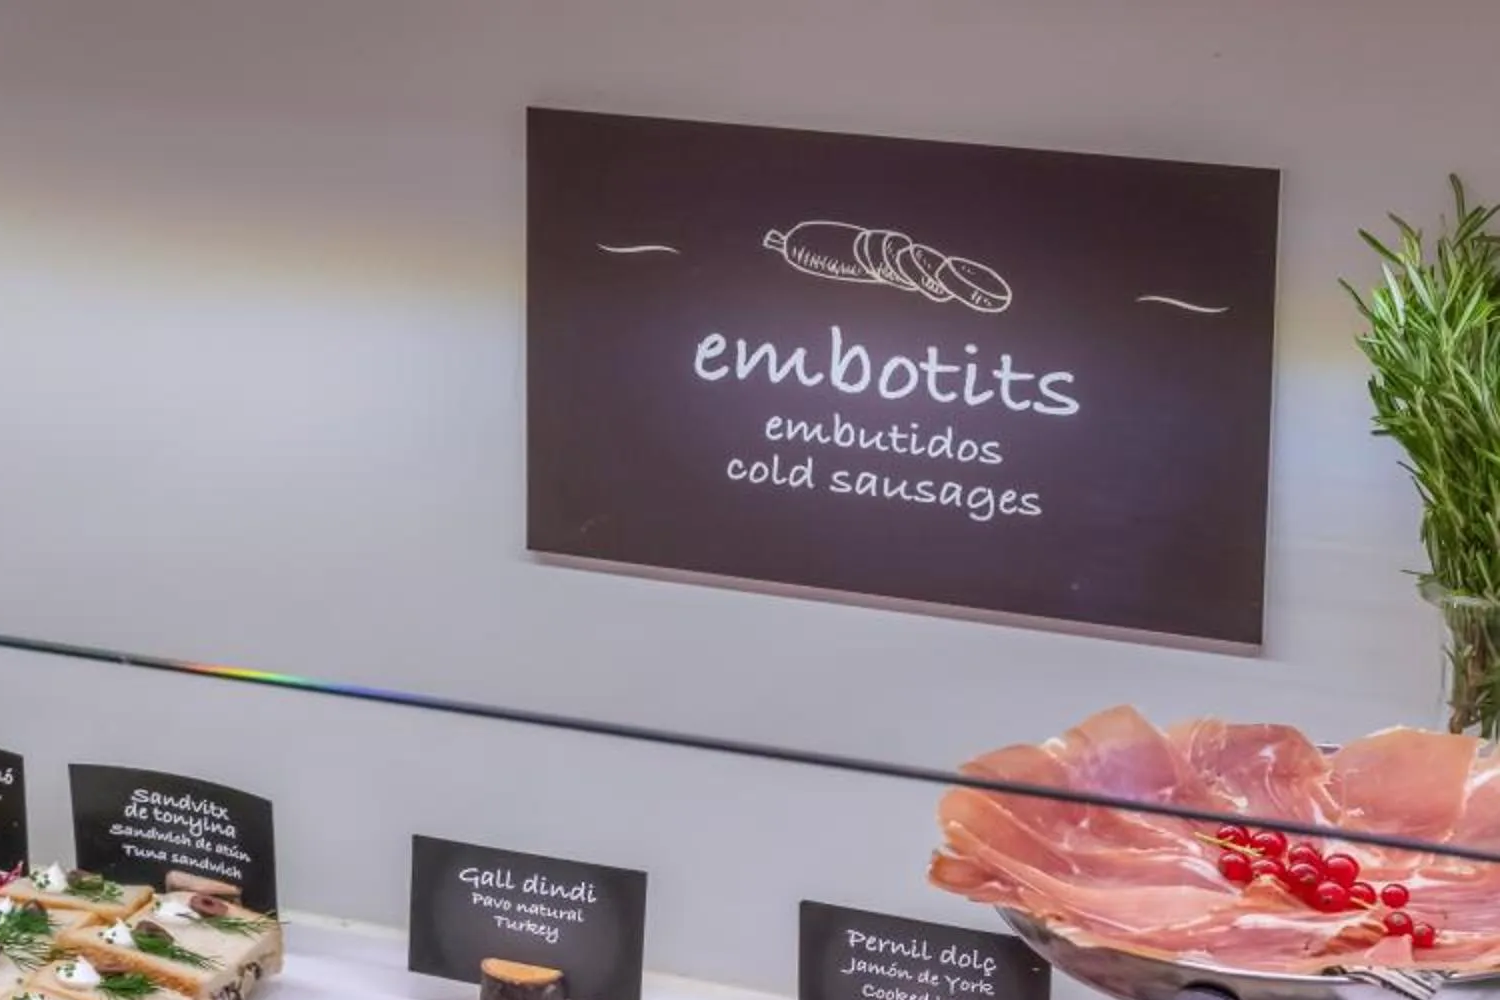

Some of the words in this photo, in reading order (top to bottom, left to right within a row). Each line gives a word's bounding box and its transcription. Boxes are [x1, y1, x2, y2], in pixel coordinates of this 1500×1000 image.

[693, 325, 1081, 417] embotits
[765, 412, 1003, 465] embutidos
[726, 456, 815, 490] cold
[830, 468, 1042, 522] sausages
[124, 803, 149, 819] de
[153, 807, 236, 839] tonyina
[131, 788, 230, 821] Sandvitx
[109, 823, 191, 847] Sandwich
[195, 838, 213, 852] de
[215, 843, 251, 863] atún
[122, 844, 167, 861] Tuna
[170, 852, 242, 880] sandwich
[458, 867, 516, 889] Gall
[522, 872, 597, 903] dindi
[471, 891, 513, 911] Pavo
[516, 903, 585, 923] natural
[493, 915, 560, 944] Turkey
[846, 928, 932, 960] Pernil
[939, 944, 997, 977] dolç
[840, 957, 913, 980] Jamón
[917, 969, 940, 986] de
[944, 975, 996, 996] York
